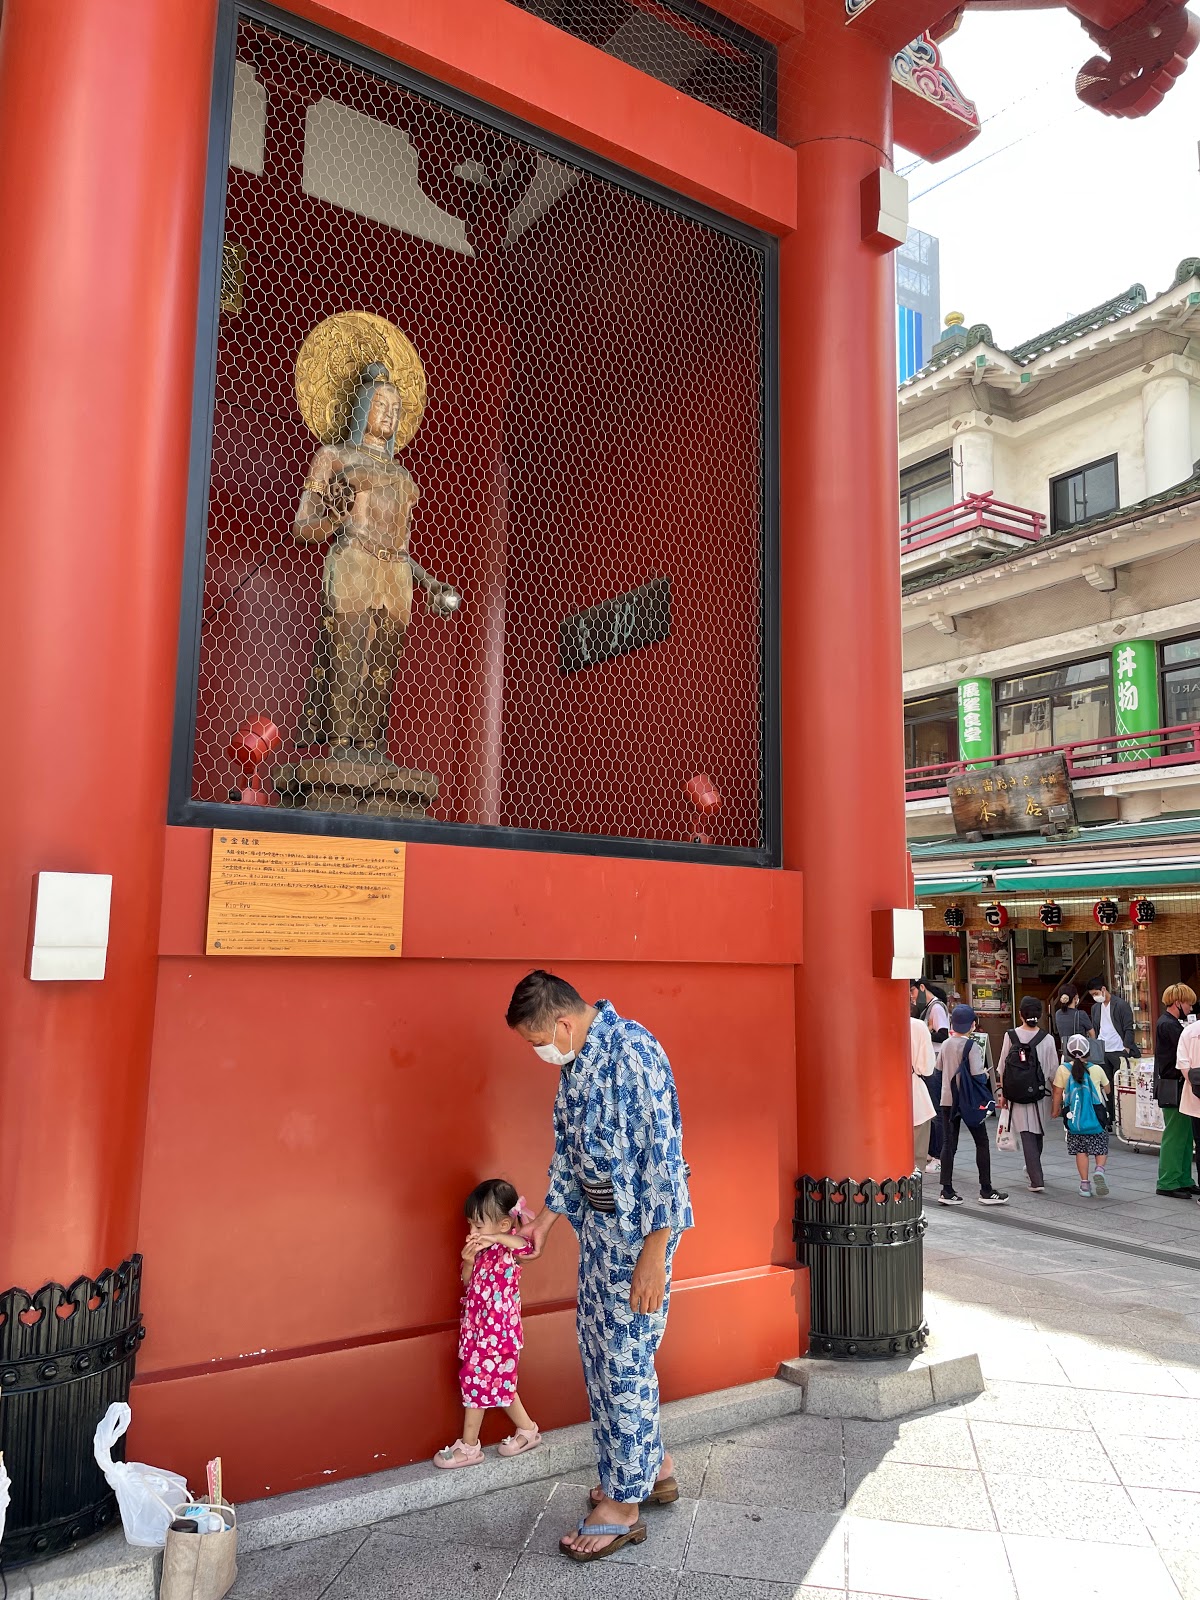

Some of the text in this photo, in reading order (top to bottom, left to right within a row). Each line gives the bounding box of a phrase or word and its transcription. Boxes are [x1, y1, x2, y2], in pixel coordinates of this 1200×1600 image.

[1116, 646, 1138, 712] 丼物
[963, 682, 982, 742] 展望食堂
[985, 904, 1002, 926] 元
[1039, 904, 1062, 926] 祖
[1096, 900, 1119, 924] 常
[1134, 900, 1156, 924] 盤
